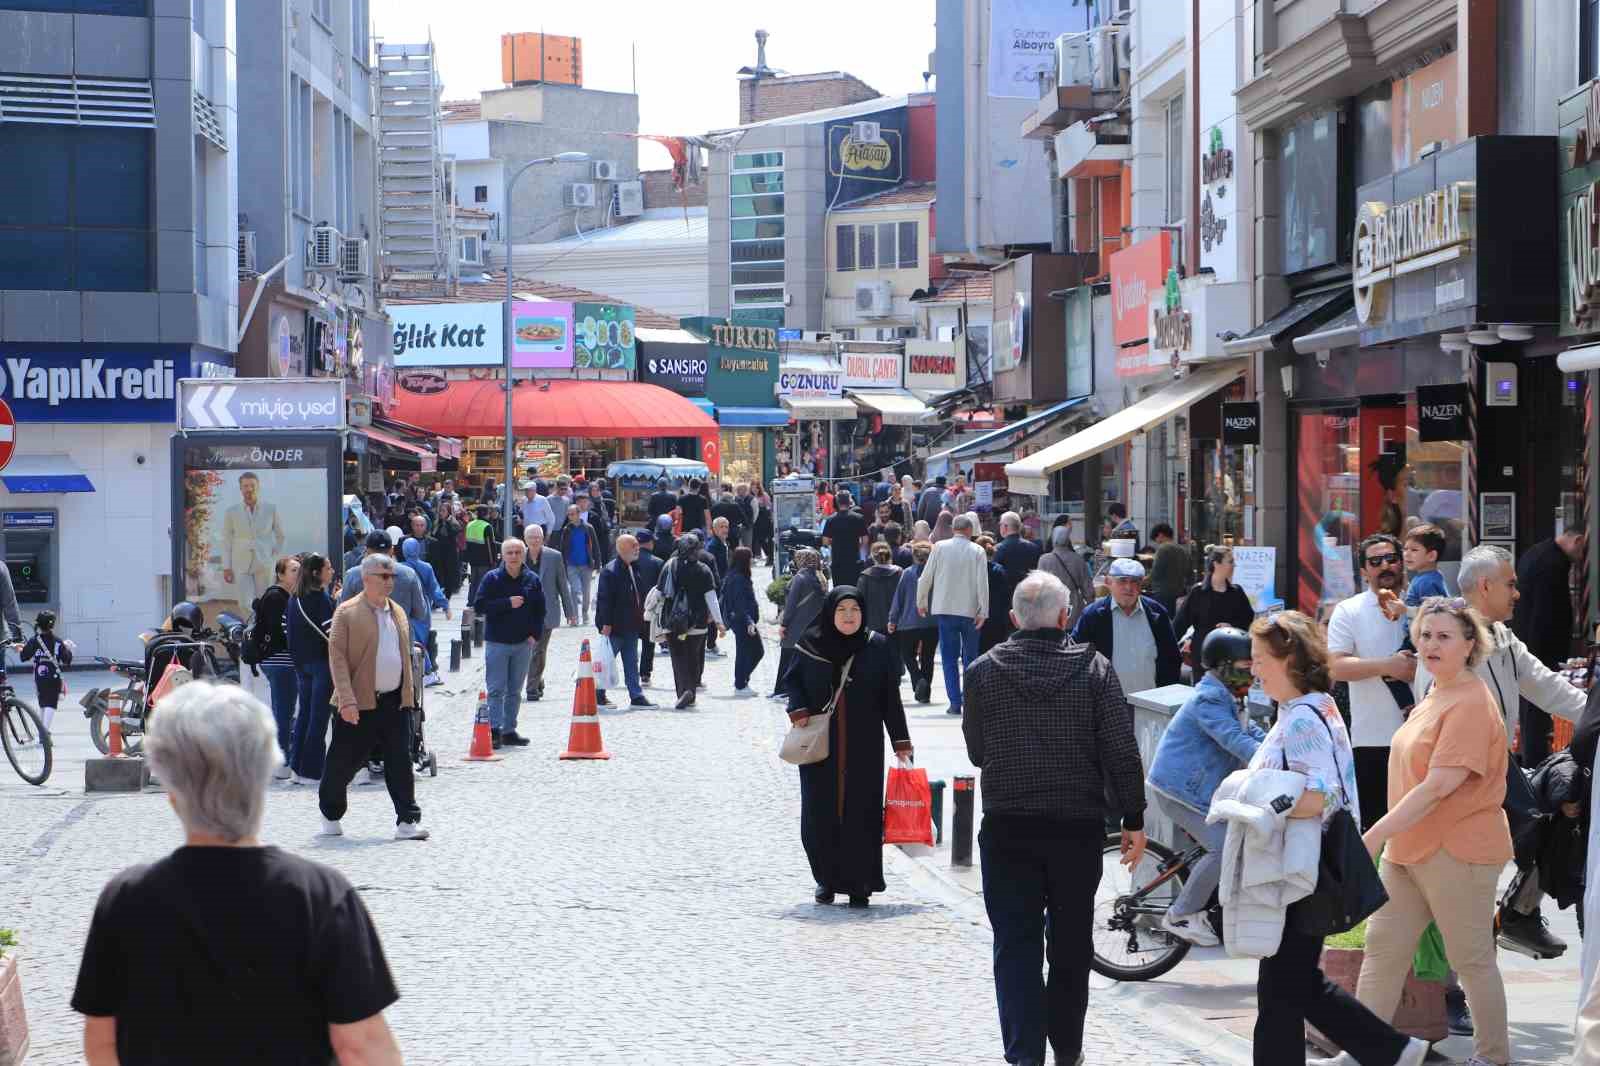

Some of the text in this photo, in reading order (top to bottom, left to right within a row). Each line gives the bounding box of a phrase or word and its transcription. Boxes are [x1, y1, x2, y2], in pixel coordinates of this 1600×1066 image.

[1013, 40, 1055, 51] Albayra
[393, 323, 486, 355] ğlık Kat
[847, 356, 870, 378] DURUL
[6, 358, 174, 406] YapıKredi
[1421, 404, 1463, 418] NAZEN
[1225, 416, 1256, 428] NAZEN
[250, 446, 303, 462] ÖNDER
